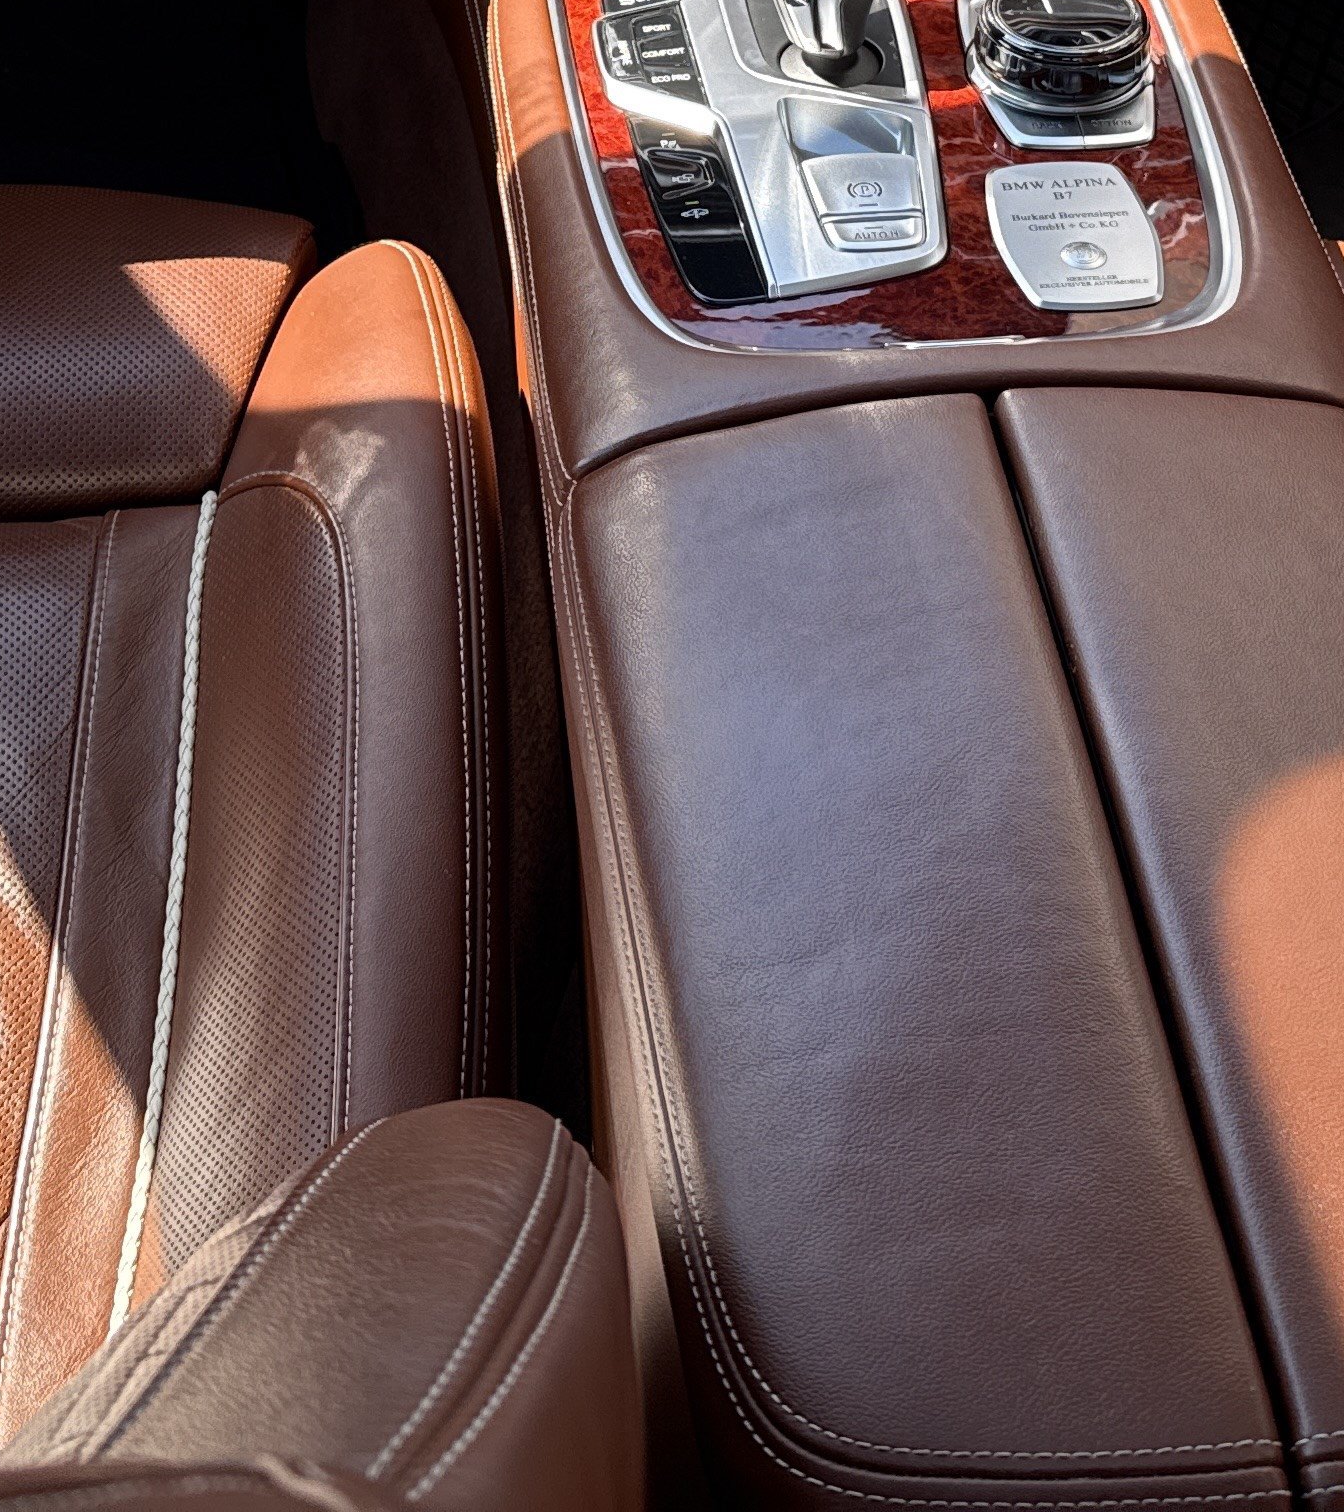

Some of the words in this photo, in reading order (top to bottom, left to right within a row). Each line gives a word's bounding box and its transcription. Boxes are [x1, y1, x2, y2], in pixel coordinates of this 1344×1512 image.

[641, 23, 672, 33] SPORT
[641, 47, 686, 59] COMFORT
[651, 74, 671, 84] ECO
[671, 73, 691, 82] PRO
[1001, 180, 1045, 192] BMW
[1050, 177, 1118, 189] ALPINA
[1053, 191, 1073, 201] B7
[1011, 213, 1057, 222] Burkard
[1059, 210, 1130, 222] Bovensiepen
[1028, 222, 1066, 232] GmbH
[854, 231, 887, 240] AUTO
